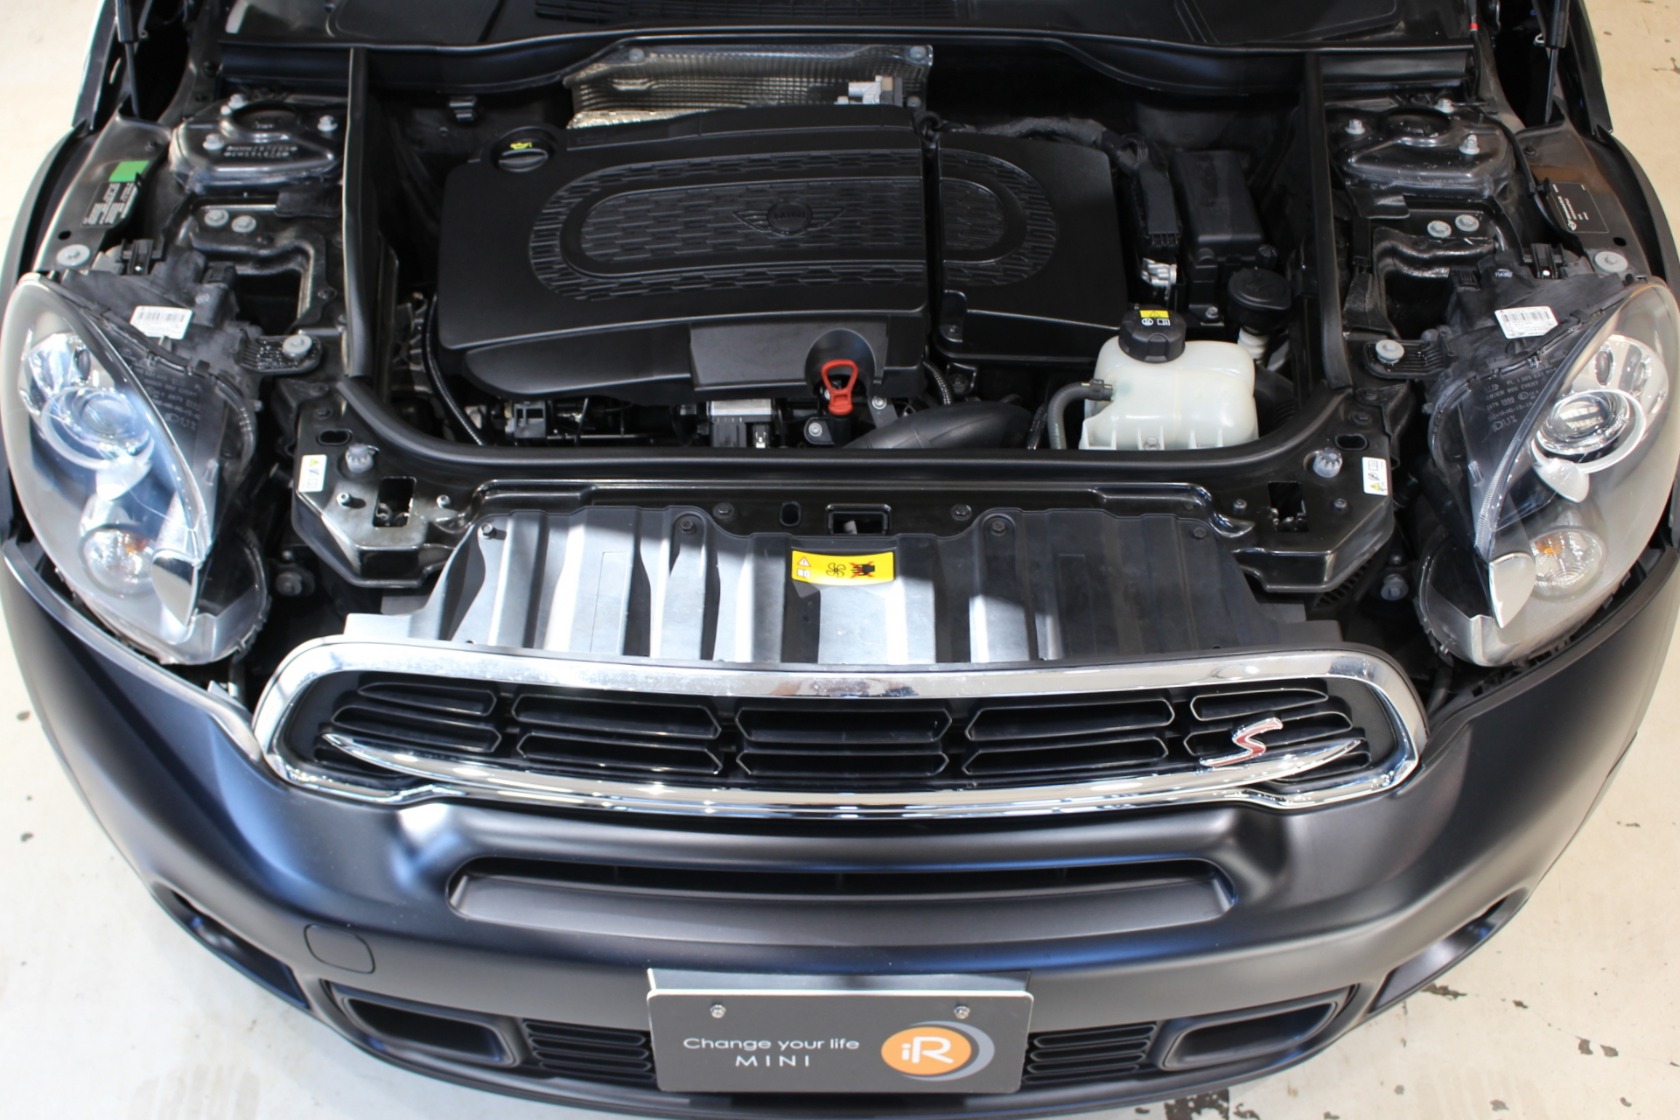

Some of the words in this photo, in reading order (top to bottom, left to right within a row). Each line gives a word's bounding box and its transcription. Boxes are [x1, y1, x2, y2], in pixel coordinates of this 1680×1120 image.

[1199, 717, 1283, 767] S
[683, 1037, 772, 1051] Change
[777, 1040, 825, 1051] your
[829, 1038, 860, 1049] life
[901, 1036, 954, 1064] iR
[735, 1055, 810, 1067] MINI
